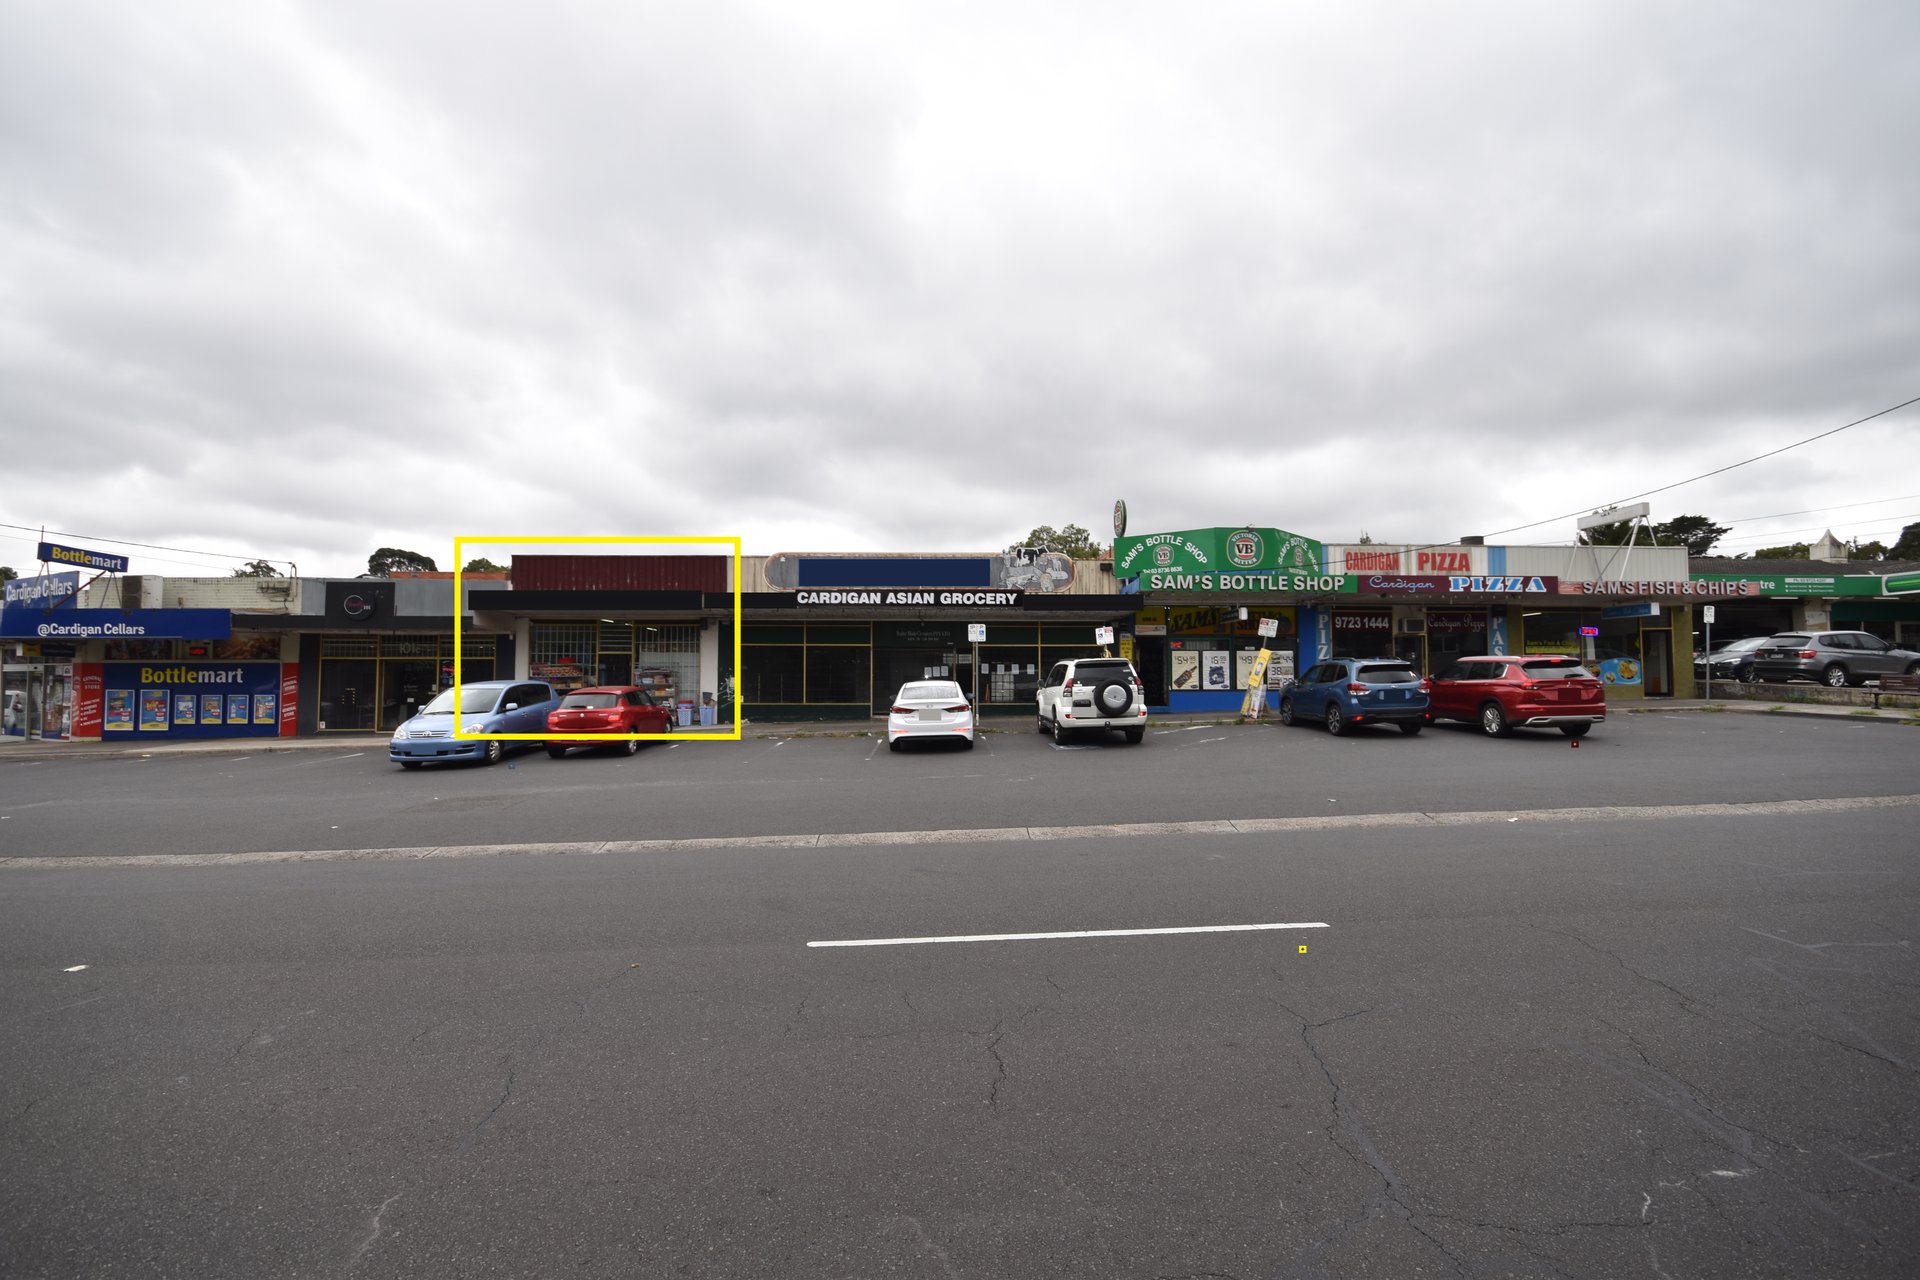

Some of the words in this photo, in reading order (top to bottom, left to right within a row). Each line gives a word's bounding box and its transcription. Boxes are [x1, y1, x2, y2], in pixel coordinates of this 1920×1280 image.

[1121, 543, 1144, 569] SAM'S
[1146, 535, 1183, 547] BOTTLE
[1184, 542, 1208, 564] SHOP
[1236, 543, 1254, 554] VB
[52, 546, 122, 570] Bottlemart
[1345, 552, 1399, 571] CARDIGAN
[1417, 552, 1471, 572] PIZZA
[1151, 574, 1213, 590] SAM'S
[1220, 574, 1289, 590] BOTTLE
[1293, 575, 1345, 591] SHOP
[1369, 575, 1435, 593] Cardigan
[1449, 576, 1547, 593] PIZZA
[1583, 580, 1635, 594] SAM'S
[1639, 580, 1677, 595] FISH
[1682, 580, 1693, 594] &
[1696, 580, 1749, 595] CHIPS
[6, 583, 42, 604] Cardigan
[797, 592, 881, 605] CARDIGAN
[886, 592, 934, 604] ASIAN
[940, 592, 1017, 605] GROCERY
[37, 623, 101, 637] @Cardigan
[104, 623, 145, 635] Cellars
[1335, 617, 1361, 628] 9723
[1363, 617, 1389, 628] 1444
[1428, 613, 1461, 632] Cardigan
[1463, 613, 1486, 632] Pizza
[141, 666, 244, 684] Bottlemart
